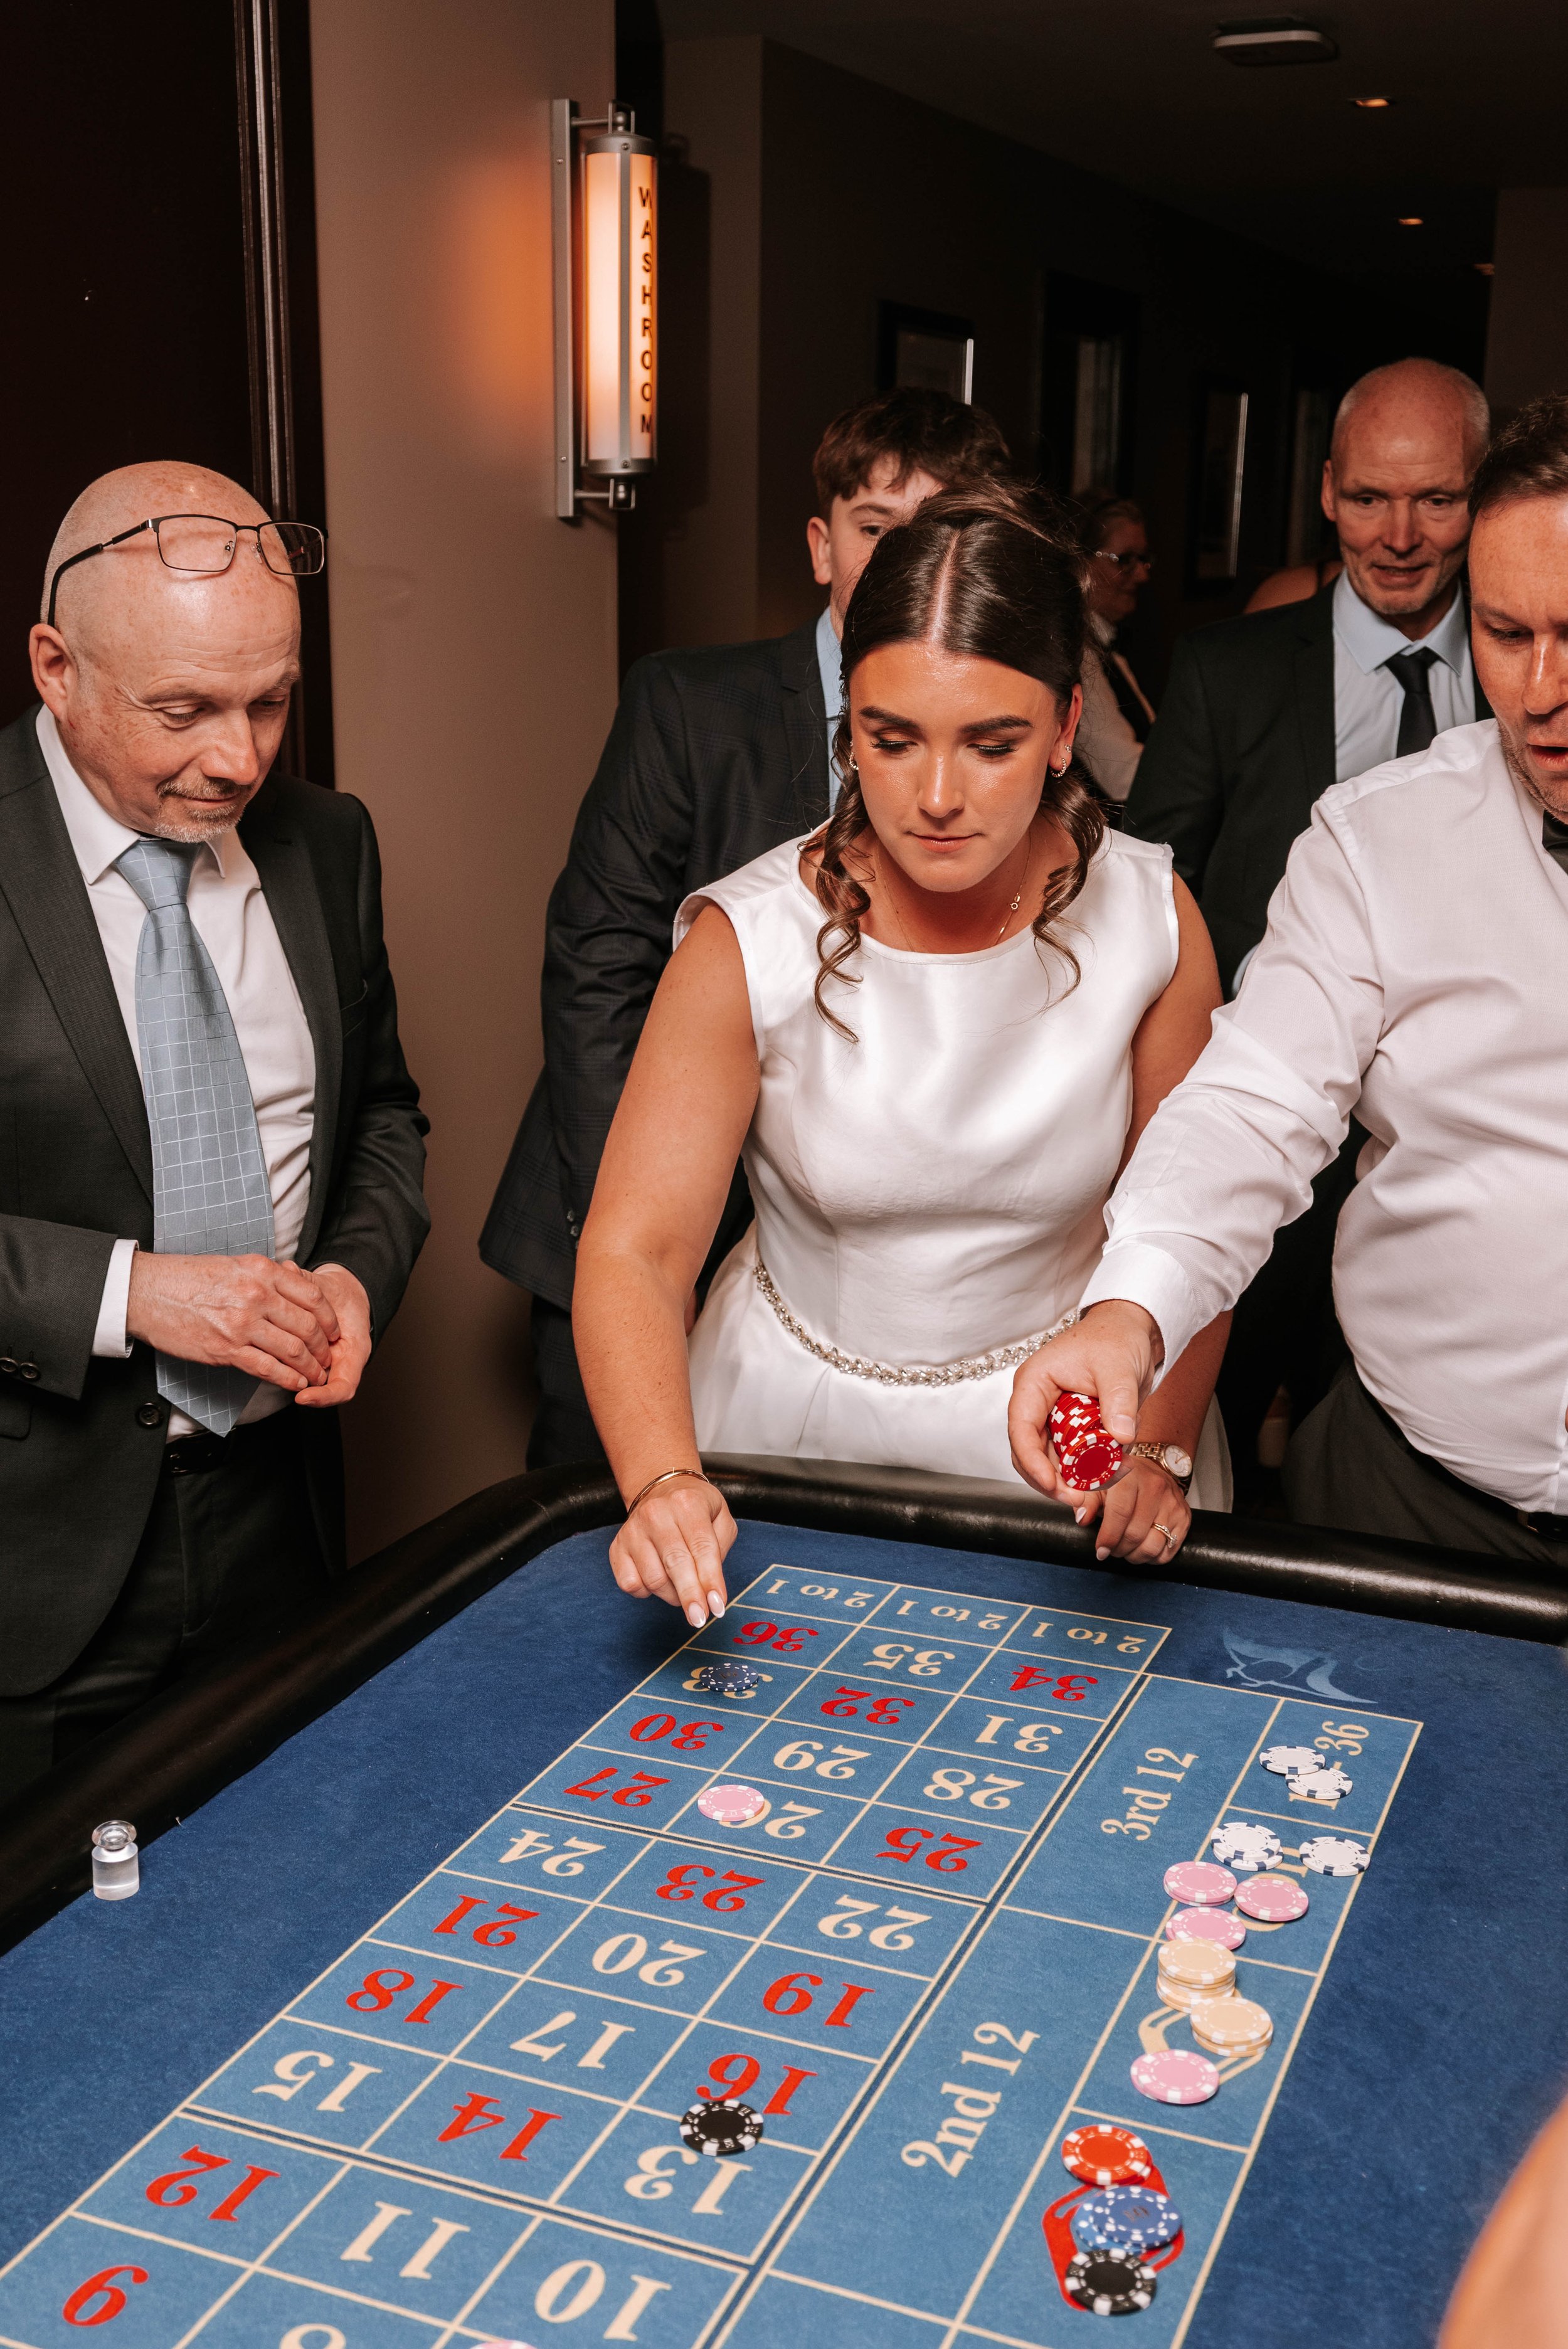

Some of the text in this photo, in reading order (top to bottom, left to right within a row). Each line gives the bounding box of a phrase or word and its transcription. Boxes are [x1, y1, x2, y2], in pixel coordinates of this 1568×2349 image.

[638, 186, 653, 433] WASHROOM
[765, 1578, 875, 1608] 2 to 1
[896, 1599, 1009, 1630] 2 to 1
[732, 1621, 818, 1652] 36
[864, 1644, 955, 1676] 35
[1030, 1621, 1147, 1653] 2 to 1
[820, 1685, 915, 1725] 32
[1009, 1665, 1098, 1701] 34
[629, 1714, 724, 1751] 30
[975, 1715, 1062, 1752] 31
[773, 1741, 870, 1779] 29
[563, 1767, 672, 1807] 27
[923, 1768, 1024, 1809] 28
[1101, 1746, 1199, 1841] 3rd 12
[499, 1830, 605, 1876] 24
[874, 1827, 983, 1872] 25
[655, 1864, 766, 1912] 23
[432, 1894, 541, 1947] 21
[818, 1895, 931, 1950] 22
[592, 1934, 706, 1986] 20
[346, 1968, 464, 2024] 18
[762, 1972, 876, 2027] 19
[511, 2012, 635, 2068] 17
[253, 2051, 381, 2111] 15
[696, 2054, 818, 2116] 16
[901, 2022, 1041, 2178] 2nd 12
[437, 2091, 562, 2162] 14
[145, 2145, 281, 2222] 12
[625, 2146, 752, 2214] 13
[341, 2202, 469, 2279] 11
[62, 2264, 149, 2327] 9
[536, 2261, 670, 2341] 10
